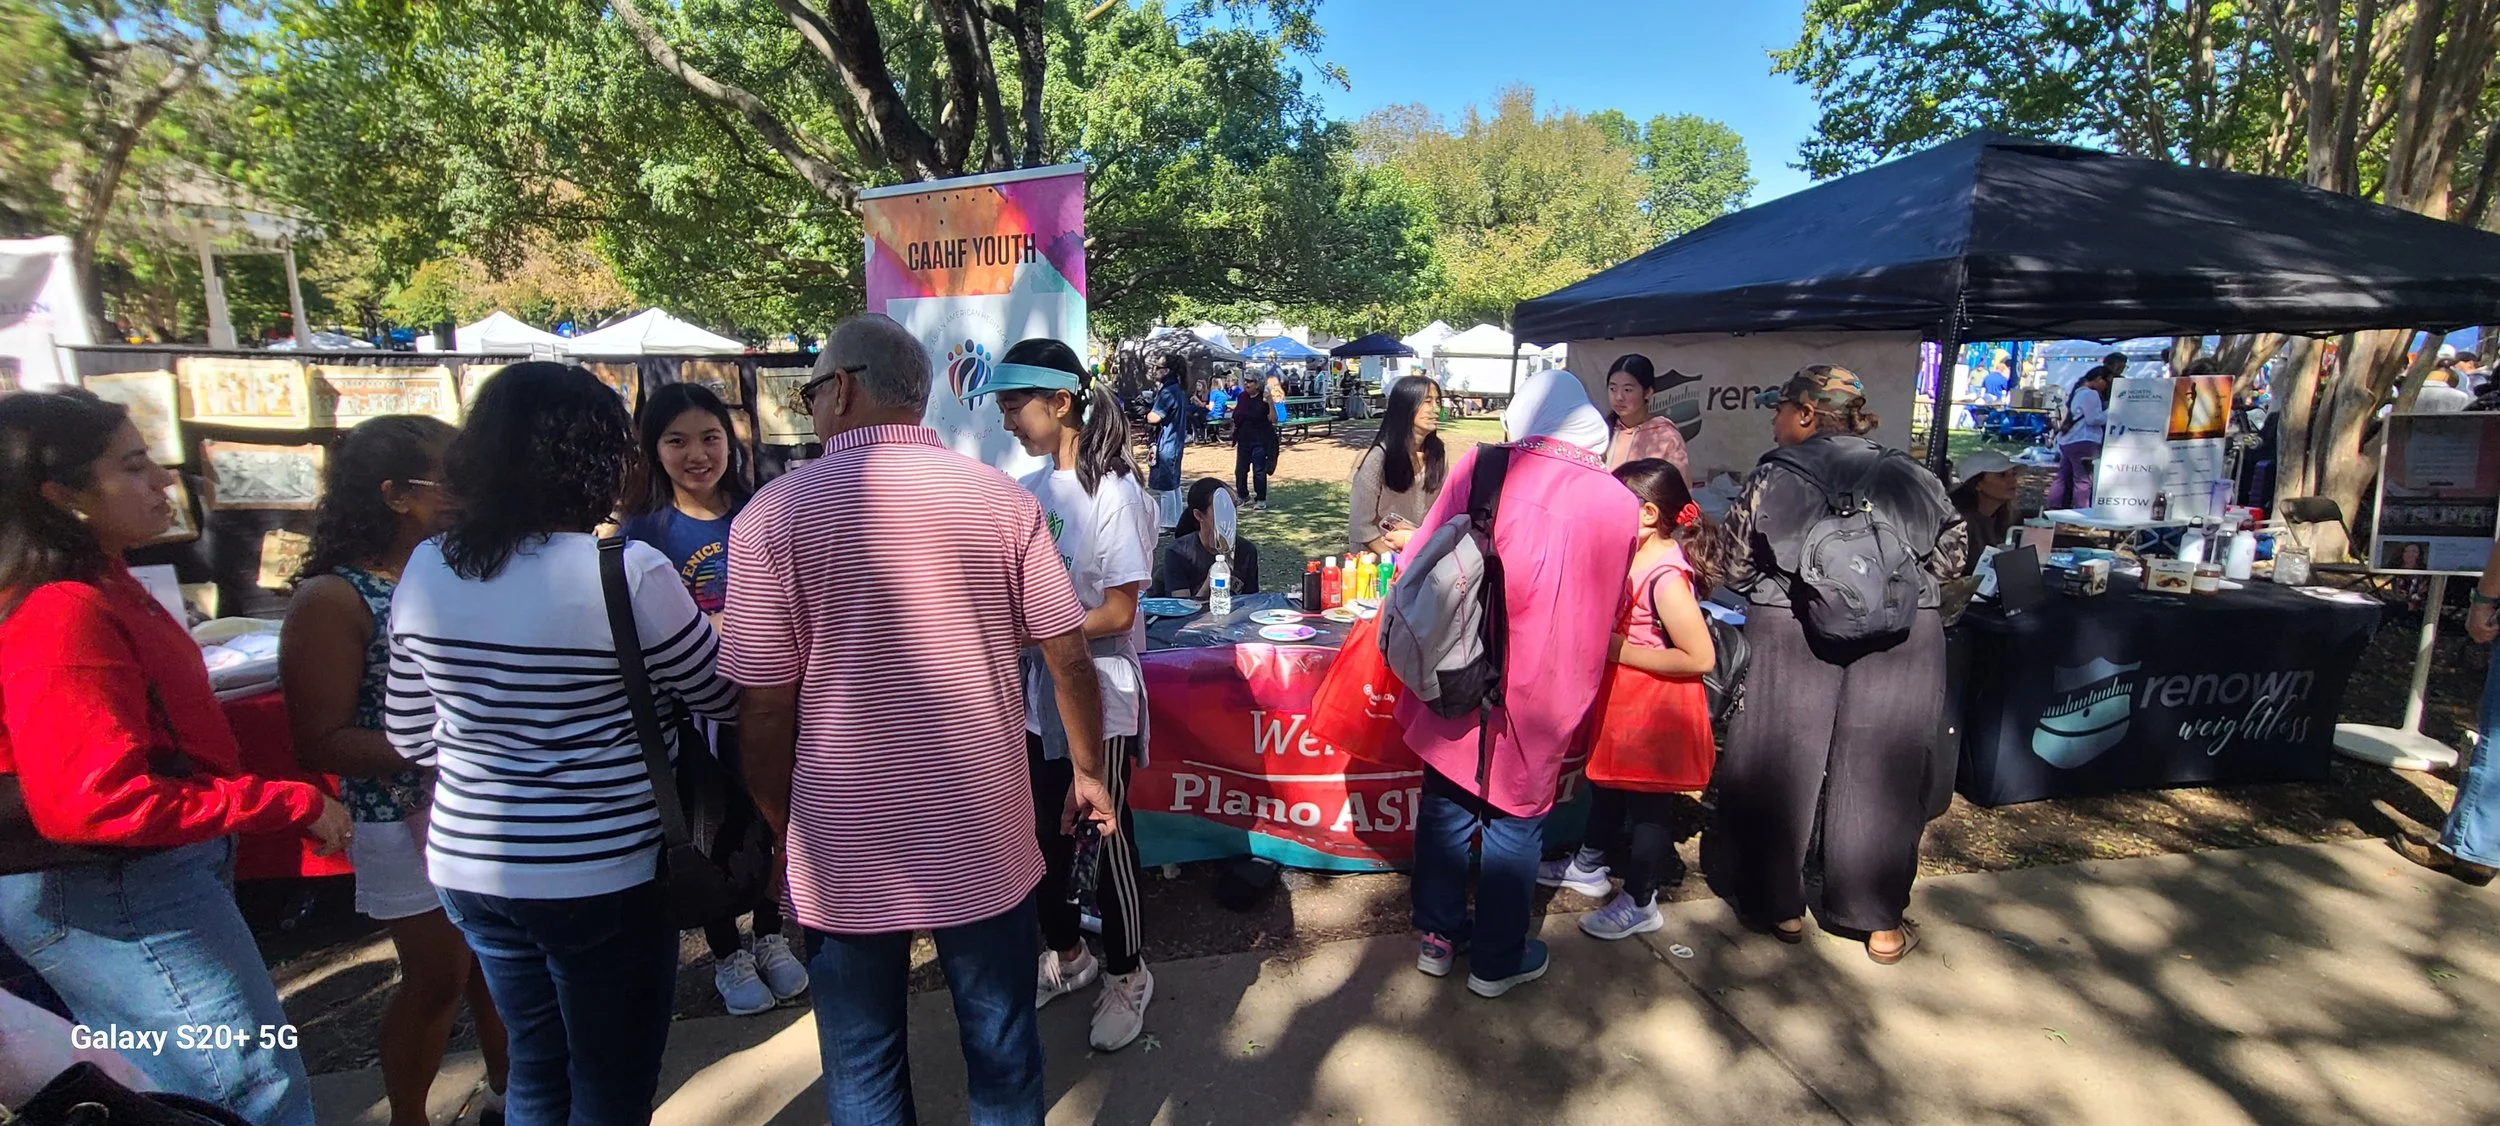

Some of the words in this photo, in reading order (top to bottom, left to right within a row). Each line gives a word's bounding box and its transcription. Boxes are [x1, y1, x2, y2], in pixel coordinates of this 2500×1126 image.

[908, 238, 967, 271] CAAHF
[972, 232, 1037, 267] YOUTH
[2114, 464, 2153, 473] ATHENE
[2097, 496, 2150, 507] BESTOW
[2139, 670, 2315, 709] renown
[1250, 710, 1335, 757] We
[1170, 772, 1321, 827] Plano
